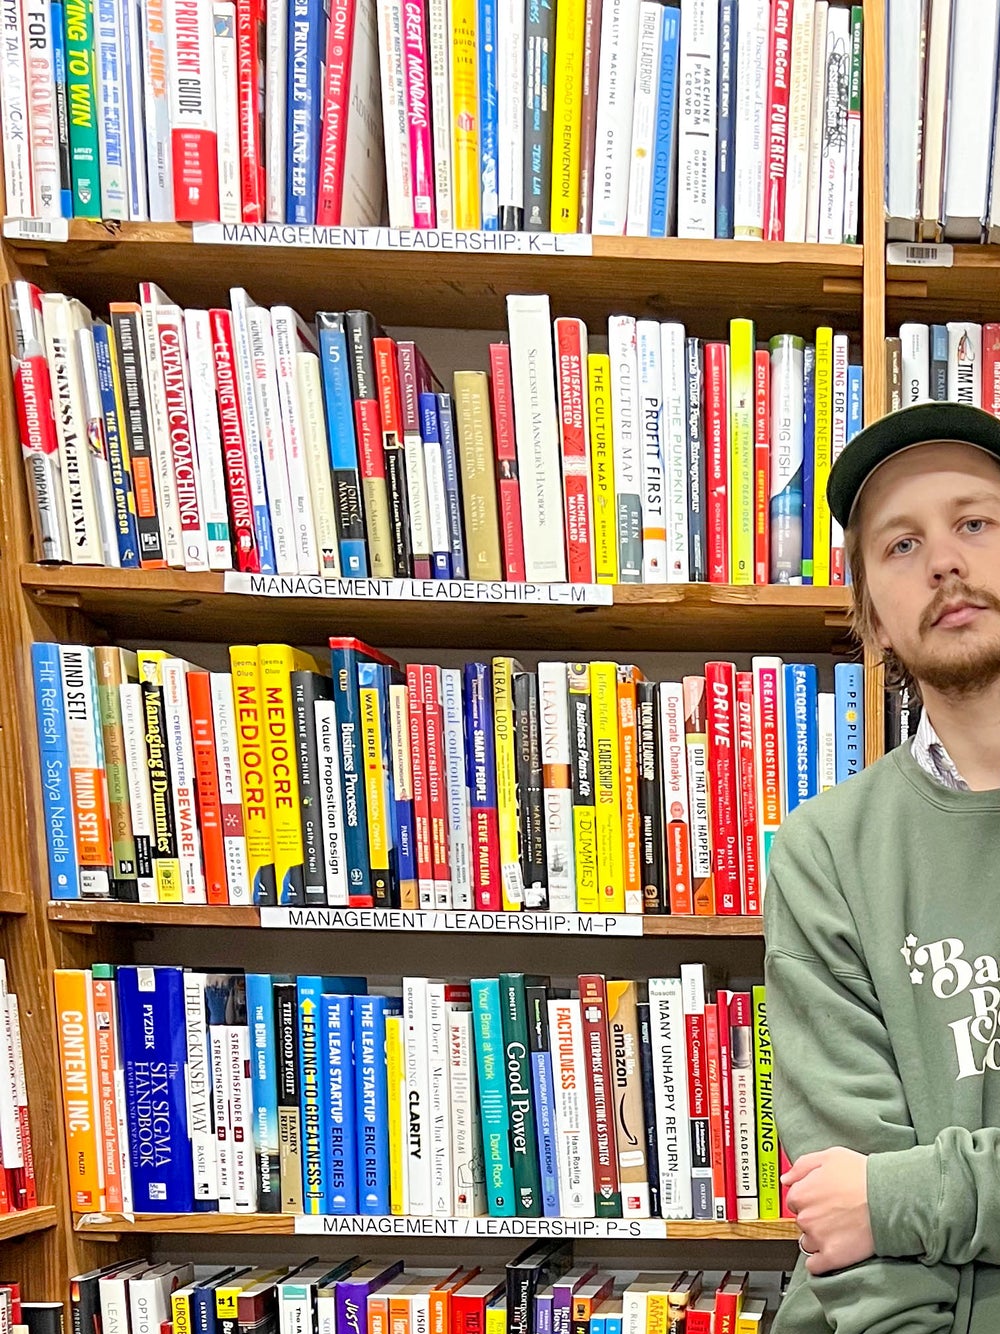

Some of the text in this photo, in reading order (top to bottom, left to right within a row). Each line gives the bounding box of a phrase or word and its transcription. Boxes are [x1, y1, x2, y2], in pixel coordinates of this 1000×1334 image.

[406, 4, 427, 128] GREAT MONDAYS
[770, 0, 789, 180] Patty McCord POWERFUL
[323, 62, 342, 195] THE ADVANTAGE
[653, 53, 674, 218] GRIDIRON GENIUS
[223, 224, 368, 248] MANAGEMENT
[375, 230, 383, 249] /
[387, 230, 522, 252] LEADERSHIP:
[159, 328, 200, 526] CATALYTIC COACHING
[213, 341, 251, 528] LEADING WITH QUESTIONS
[644, 397, 662, 516] PROFIT FIRST
[250, 575, 391, 597] MANAGEMENT
[399, 579, 405, 598] /
[411, 580, 541, 600] LEADERSHIP:
[38, 660, 58, 745] Hit Refresh
[237, 687, 265, 820] MEDIOCRE
[267, 688, 293, 810] MEDIOCRE
[46, 759, 67, 863] Satya Nadella
[289, 909, 427, 928] MANAGEMENT
[433, 916, 438, 930] /
[445, 916, 571, 931] LEADERSHIP:
[60, 1010, 91, 1138] CONTENT INC.
[328, 1003, 344, 1124] THE LEAN STARTUP
[506, 1041, 529, 1154] Good Power
[556, 1007, 576, 1090] FACTFULNESS
[408, 1089, 422, 1159] CLARITY
[323, 1218, 460, 1234] MANAGEMENT
[464, 1219, 470, 1234] /
[476, 1219, 599, 1235] LEADERSHIP:
